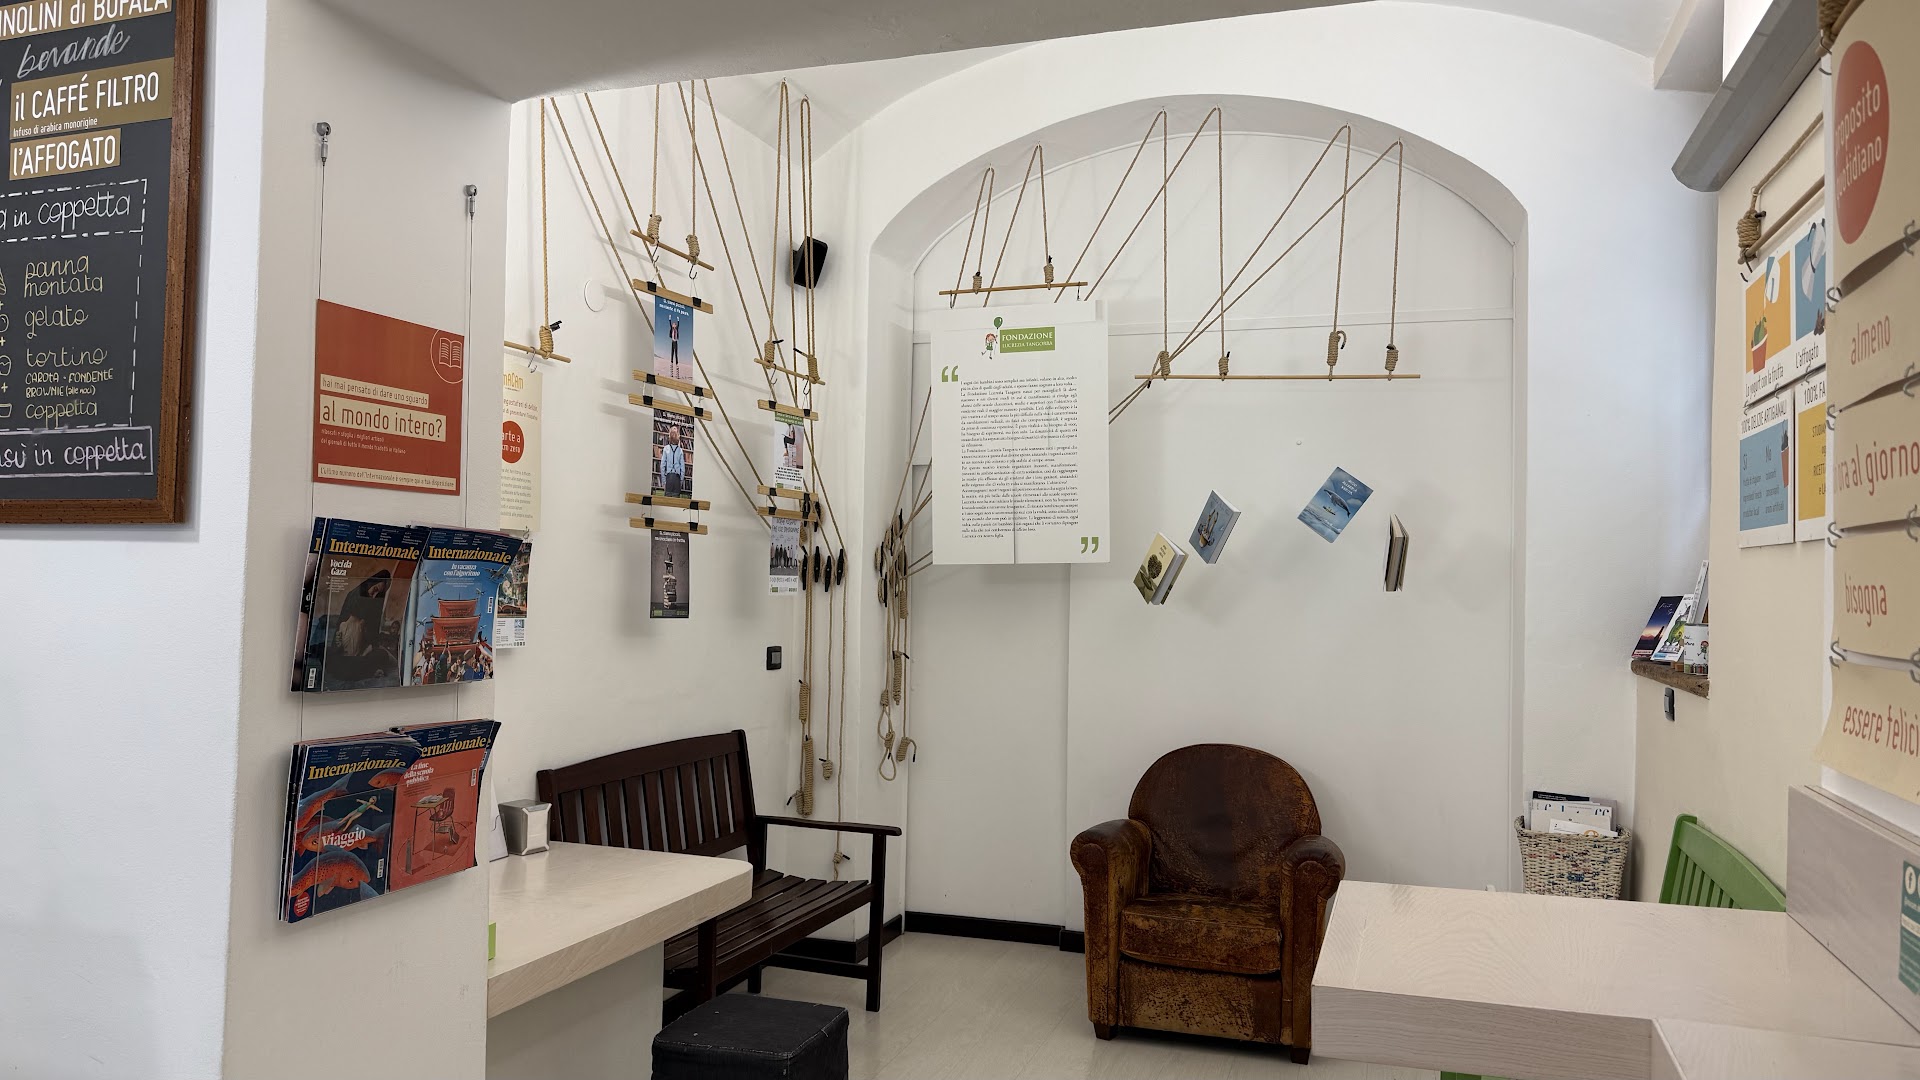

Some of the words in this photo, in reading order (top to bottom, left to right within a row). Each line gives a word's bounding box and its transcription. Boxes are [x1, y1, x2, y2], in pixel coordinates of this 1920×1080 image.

[0, 1, 62, 37] NOLINI
[70, 0, 85, 25] di
[17, 23, 131, 79] bevande
[15, 92, 25, 121] il
[32, 73, 89, 119] CAFFÉ
[96, 71, 159, 109] FILTRO
[13, 127, 32, 137] Infuso
[33, 125, 39, 134] di
[40, 122, 62, 133] arabica
[63, 117, 98, 130] monorigine
[13, 210, 32, 228] in
[38, 191, 131, 233] coppetta
[25, 255, 89, 281] panna
[24, 275, 103, 298] montata
[25, 305, 89, 340] gelato
[1002, 332, 1053, 341] FONDAZIONE
[1851, 315, 1892, 366] almeno
[26, 346, 108, 368] tortino
[25, 373, 60, 384] CAROTA
[68, 368, 114, 383] FONDENTE
[25, 386, 65, 398] BROWNIE
[322, 378, 333, 388] hai
[334, 381, 346, 390] mai
[347, 383, 371, 395] pensato
[372, 387, 379, 396] di
[380, 388, 393, 399] dare
[394, 393, 405, 401] uno
[405, 394, 428, 405] sguardo
[1804, 384, 1818, 405] 100%
[26, 400, 98, 428] coppetta
[322, 400, 336, 422] al
[341, 408, 389, 430] mondo
[395, 412, 443, 439] intero?
[34, 443, 55, 466] in
[64, 437, 147, 470] coppetta
[1851, 443, 1863, 487] al
[1865, 441, 1920, 497] giorno
[329, 538, 420, 560] Internazionale
[427, 545, 512, 564] Internazionale
[330, 559, 344, 568] Voci
[330, 567, 347, 576] Gaza
[1844, 572, 1888, 628] bisogna
[1842, 705, 1883, 744] essere
[420, 736, 487, 758] ernazionale
[307, 757, 407, 780] Internazionale
[404, 770, 417, 779] della
[321, 827, 366, 848] Viaggio
